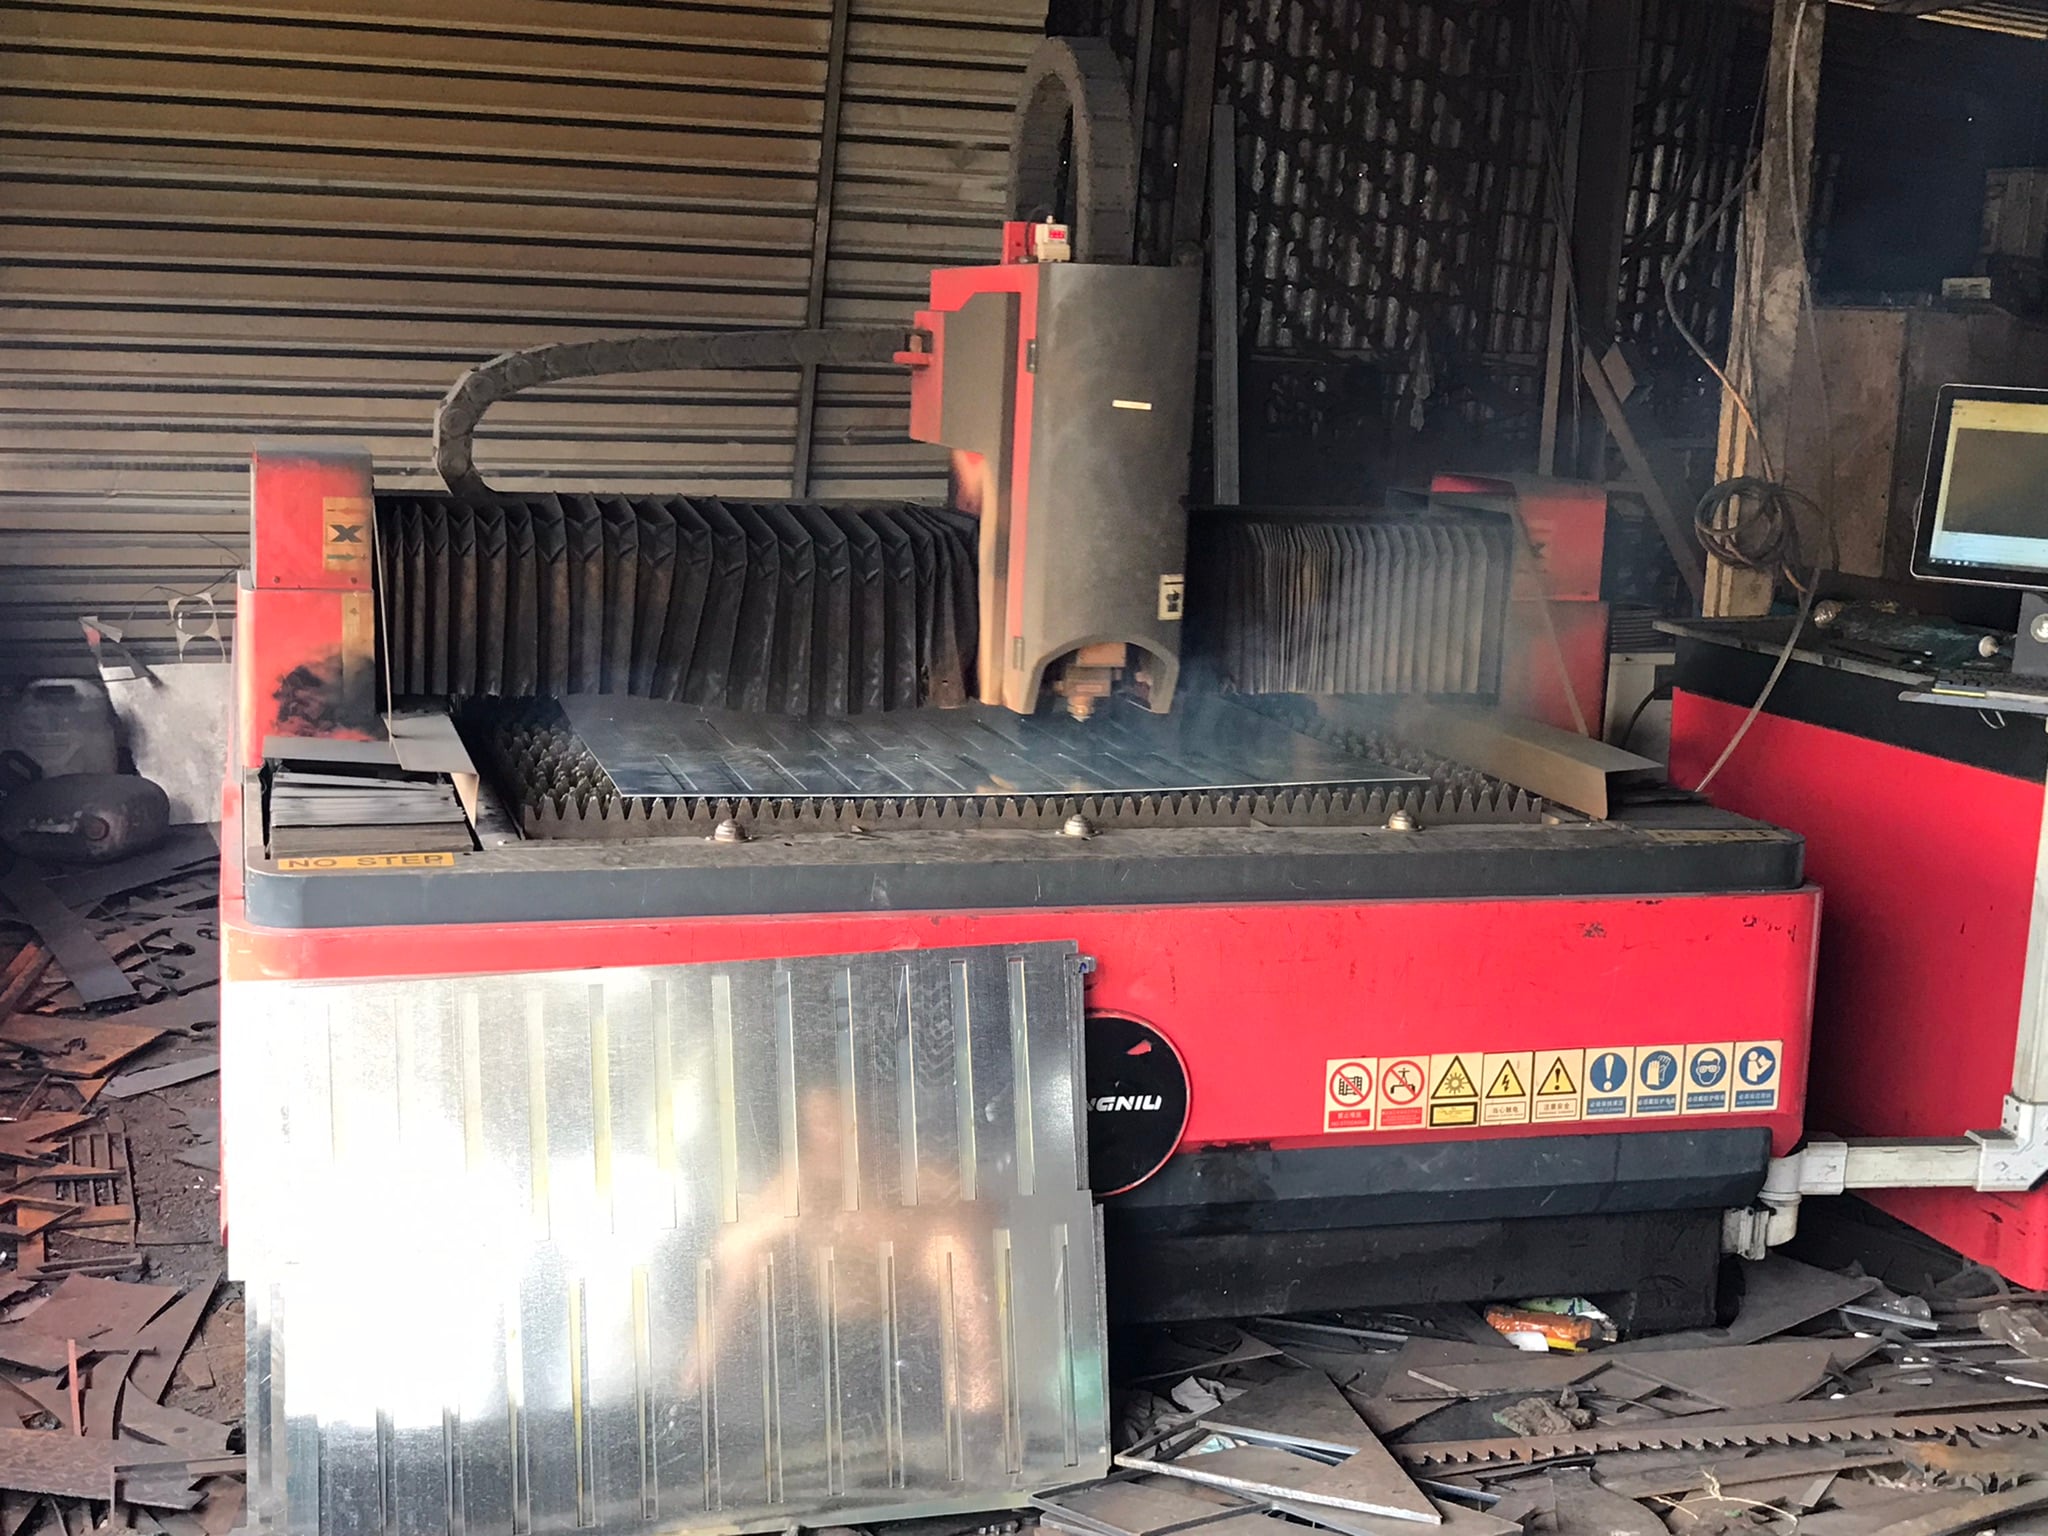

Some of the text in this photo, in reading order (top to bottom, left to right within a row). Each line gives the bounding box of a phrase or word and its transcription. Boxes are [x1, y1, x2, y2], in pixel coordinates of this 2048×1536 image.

[329, 524, 363, 543] X
[288, 854, 443, 868] NO STEP
